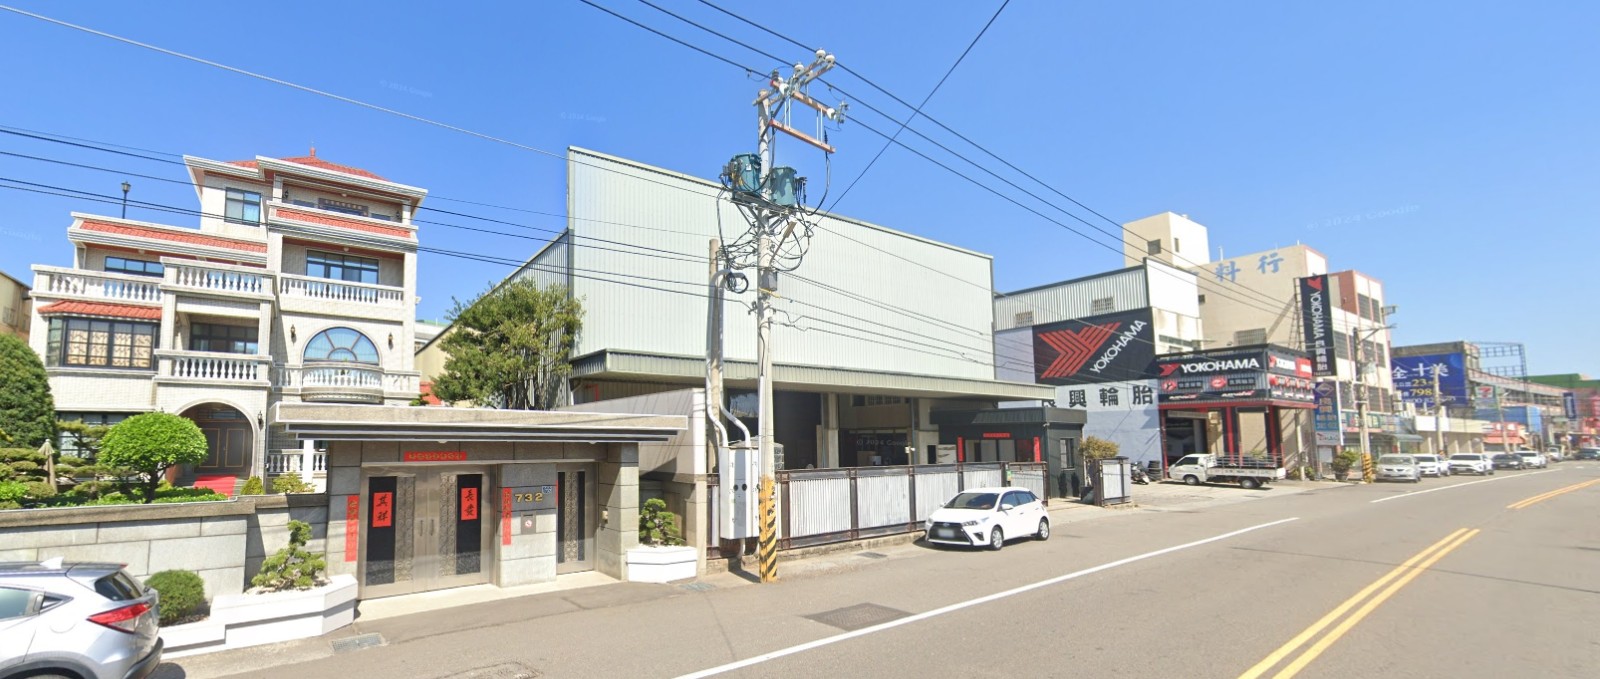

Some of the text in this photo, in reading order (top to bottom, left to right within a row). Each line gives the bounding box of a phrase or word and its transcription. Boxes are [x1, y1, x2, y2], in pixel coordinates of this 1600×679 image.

[1309, 291, 1325, 339] YOKOHAMA
[1089, 319, 1148, 374] YOKOHAMA
[1180, 358, 1260, 373] YOKOHAMA
[515, 492, 543, 503] 732
